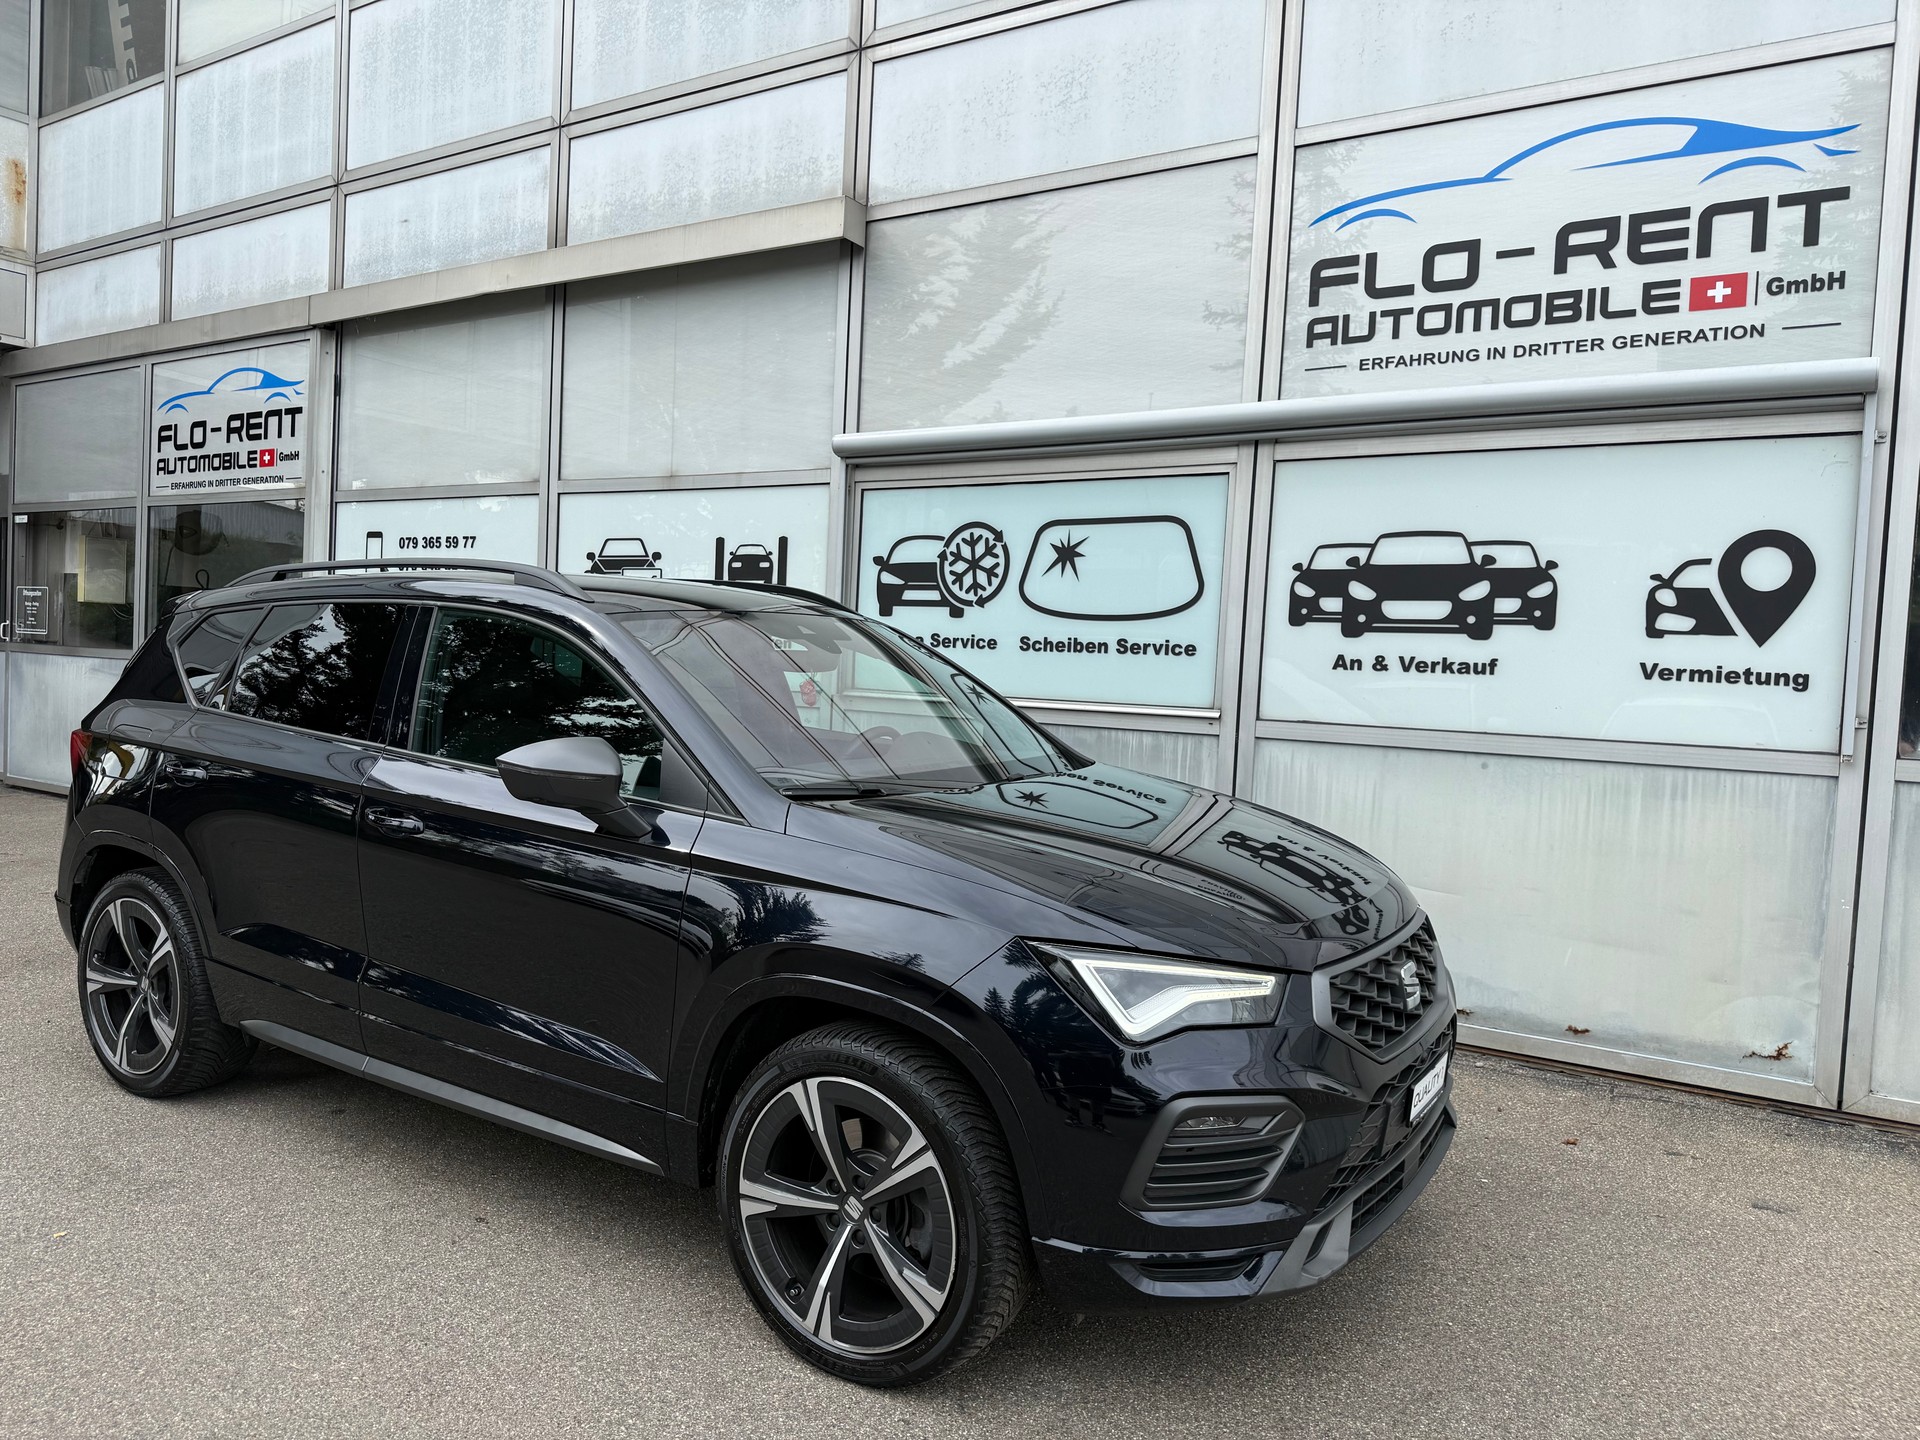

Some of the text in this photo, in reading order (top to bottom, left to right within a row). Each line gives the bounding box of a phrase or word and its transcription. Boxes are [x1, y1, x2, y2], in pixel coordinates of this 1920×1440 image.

[1305, 269, 1846, 349] AUTOMOBILE GmbH
[1358, 322, 1766, 372] ERFAHRUNG IN DRITTER GENERATION
[156, 450, 300, 476] AUTOMOBILE GmbH
[170, 475, 284, 490] ERFAHRUNG IN DRITTER GENERATION
[399, 535, 476, 549] 079 365 59 77
[930, 632, 998, 650] Service
[1018, 635, 1198, 657] Scheiben Service
[1331, 654, 1499, 677] An & Verkauf
[1639, 661, 1811, 692] Vermietung
